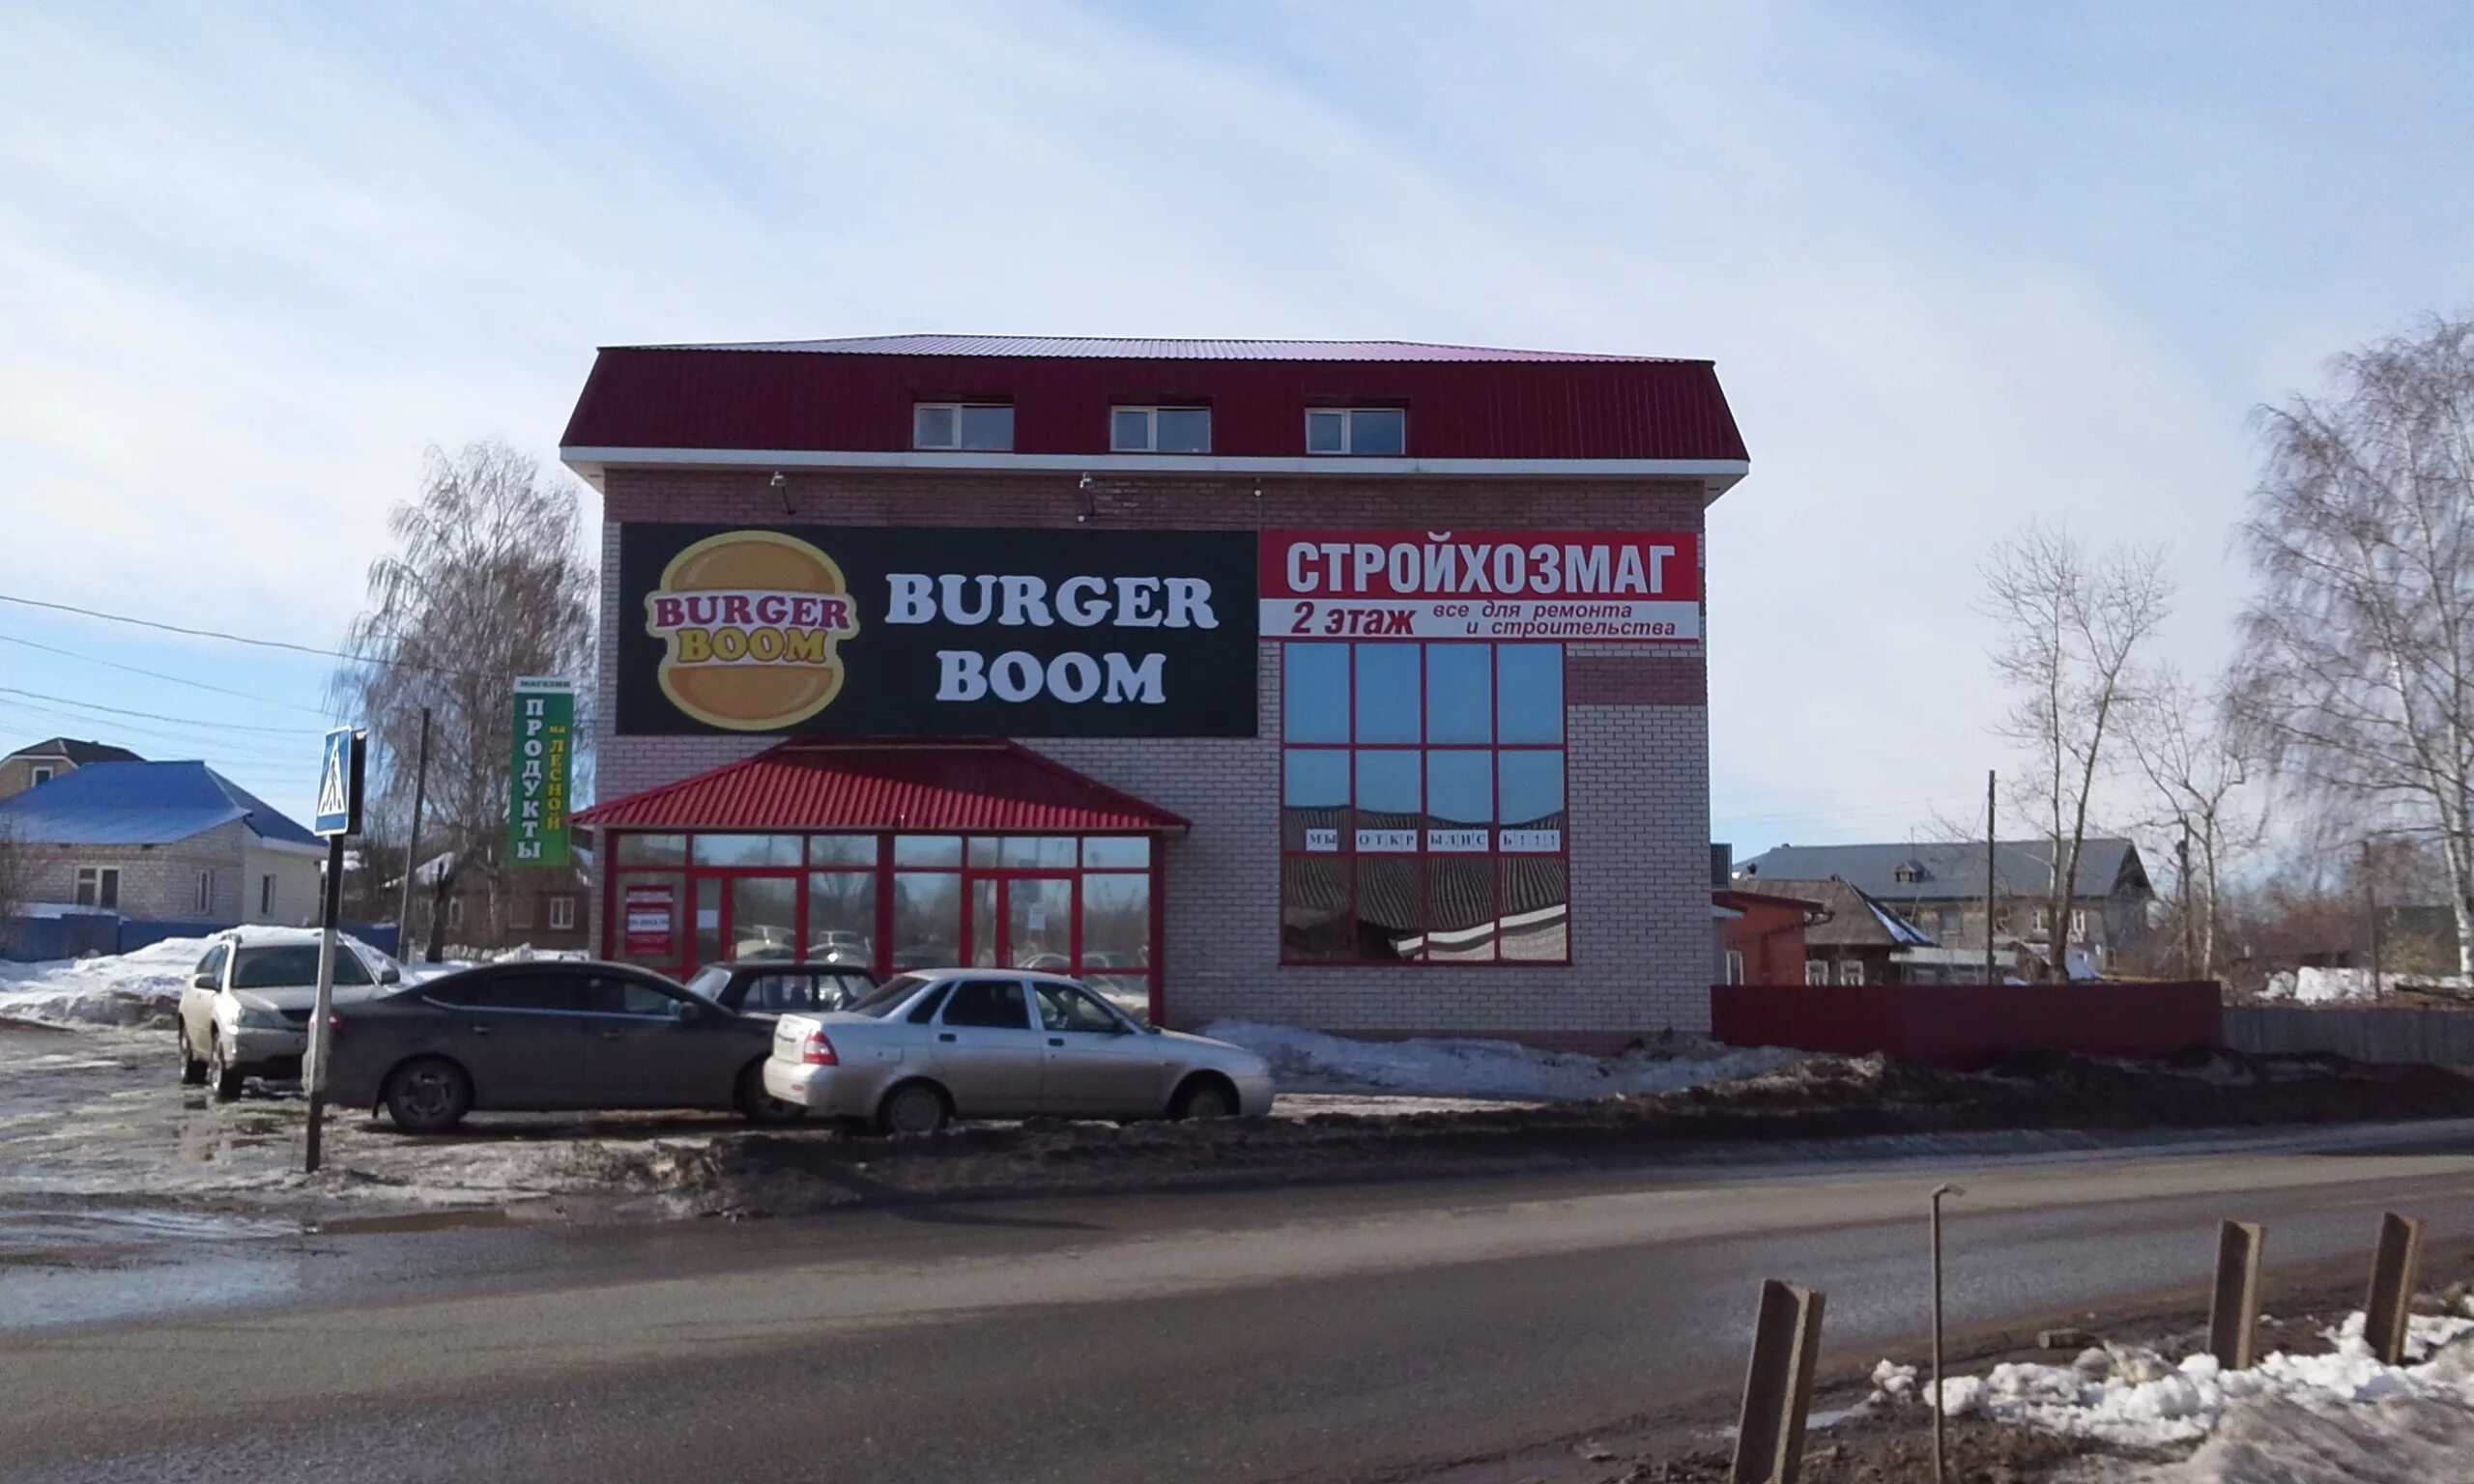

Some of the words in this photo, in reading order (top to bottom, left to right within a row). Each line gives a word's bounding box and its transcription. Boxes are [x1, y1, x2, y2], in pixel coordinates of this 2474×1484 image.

[1286, 530, 1676, 594] СТРОЙХОЗМАГ
[653, 594, 851, 630] BURGER
[884, 572, 1220, 629] BURGER
[1290, 601, 1316, 635] 2
[1323, 608, 1417, 636] этаж
[1432, 604, 1470, 619] все
[1482, 600, 1522, 619] для
[1533, 604, 1633, 623] ремонта
[676, 628, 827, 664] BOOM
[1465, 622, 1479, 636] и
[1491, 619, 1677, 638] строительства
[935, 650, 1167, 705] BOOM
[516, 699, 544, 859] ПРОДУКТЫ
[546, 738, 564, 830] ЛЕСНОЙ
